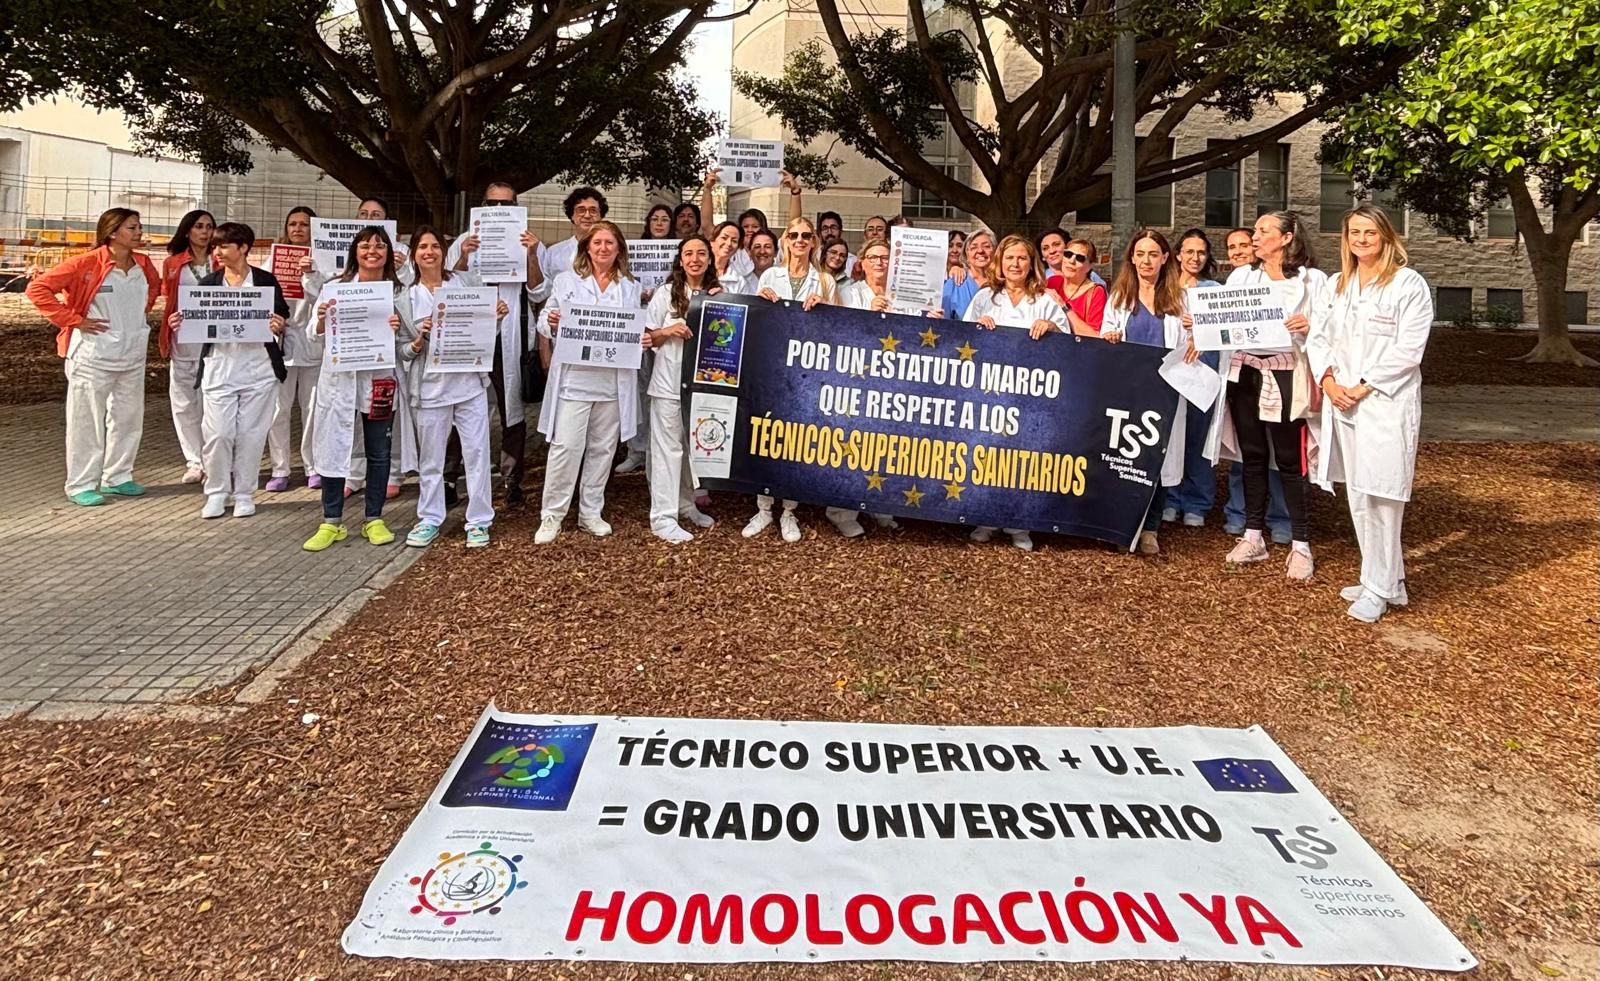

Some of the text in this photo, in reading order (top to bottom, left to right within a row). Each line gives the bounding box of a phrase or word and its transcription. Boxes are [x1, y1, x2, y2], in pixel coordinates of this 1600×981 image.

[1219, 289, 1247, 298] ESTATUTO
[1248, 287, 1270, 296] MARCO
[1220, 300, 1244, 308] RESPETE
[208, 309, 239, 320] SUPERIORES
[240, 310, 270, 320] SANITARIOS
[591, 310, 616, 319] ESTATUTO
[1218, 310, 1250, 323] SUPERIORES
[1251, 308, 1284, 321] SANITARIOS
[232, 325, 245, 334] TSS
[590, 320, 611, 328] RESPETE
[585, 329, 614, 342] SUPERIORES
[614, 332, 640, 344] SANITARIOS
[1245, 327, 1258, 338] TSS
[605, 347, 616, 358] TSS
[786, 339, 1061, 399] POR UN ESTATUTO MARCO
[819, 384, 1020, 435] QUE RESPETE A LOS
[1106, 408, 1162, 459] TSS
[750, 411, 1087, 497] TÉCNICOS SUPERIORES SANITARIOS
[1101, 453, 1133, 465] Técnicos
[1109, 462, 1147, 477] Superiores
[1119, 472, 1153, 486] Sanitarios
[492, 724, 537, 733] IMAGEN
[618, 729, 1184, 776] TÉCNICO SUPERIOR + U.E.
[598, 799, 1223, 843] = GRADO UNIVERSITARIO
[1251, 825, 1338, 870] TSS
[1296, 875, 1373, 888] Técnicos
[1300, 888, 1395, 903] Superiores
[565, 876, 1303, 948] HOMOLOGACIÓN YA
[1314, 904, 1405, 918] Sanitarios
